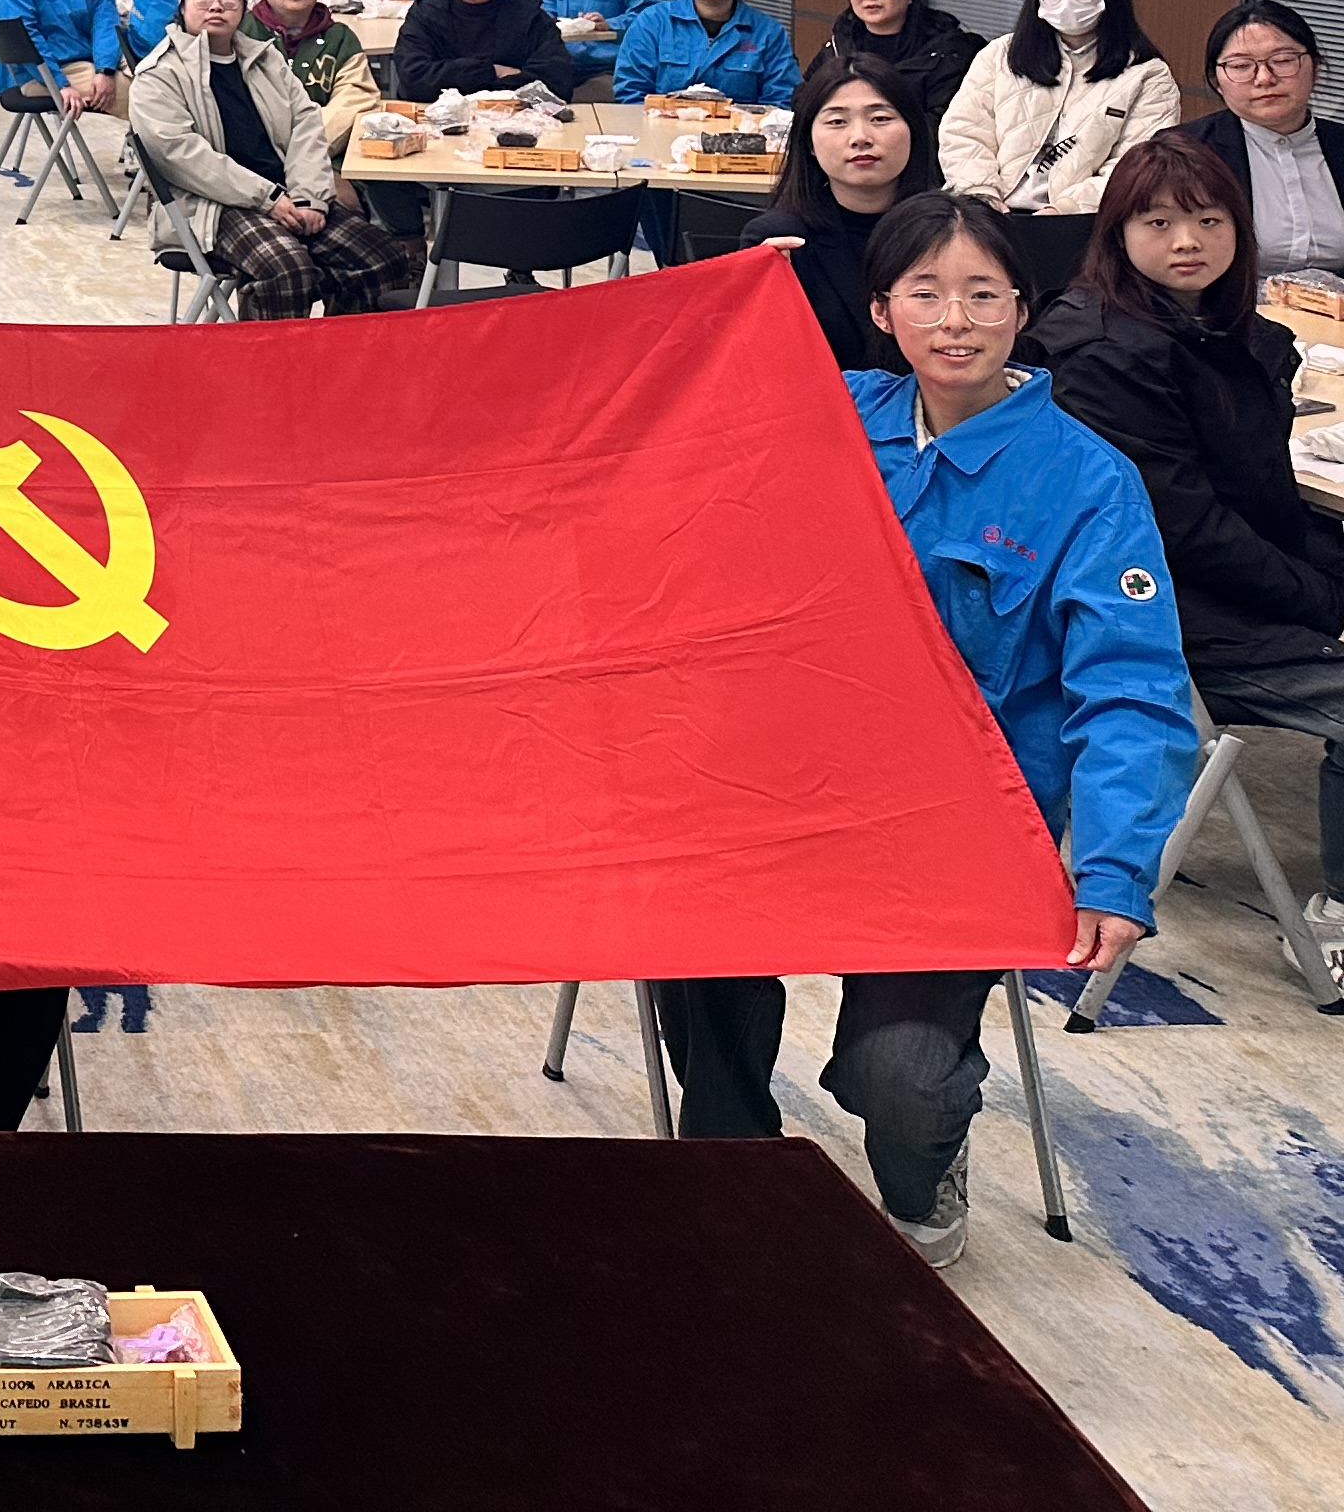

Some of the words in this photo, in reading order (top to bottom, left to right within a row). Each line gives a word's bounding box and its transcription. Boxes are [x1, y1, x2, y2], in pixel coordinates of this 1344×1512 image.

[1, 1380, 36, 1390] 100%
[47, 1379, 111, 1389] ARABICA
[0, 1398, 50, 1409] CAFEDO
[59, 1398, 111, 1409] BRASIL
